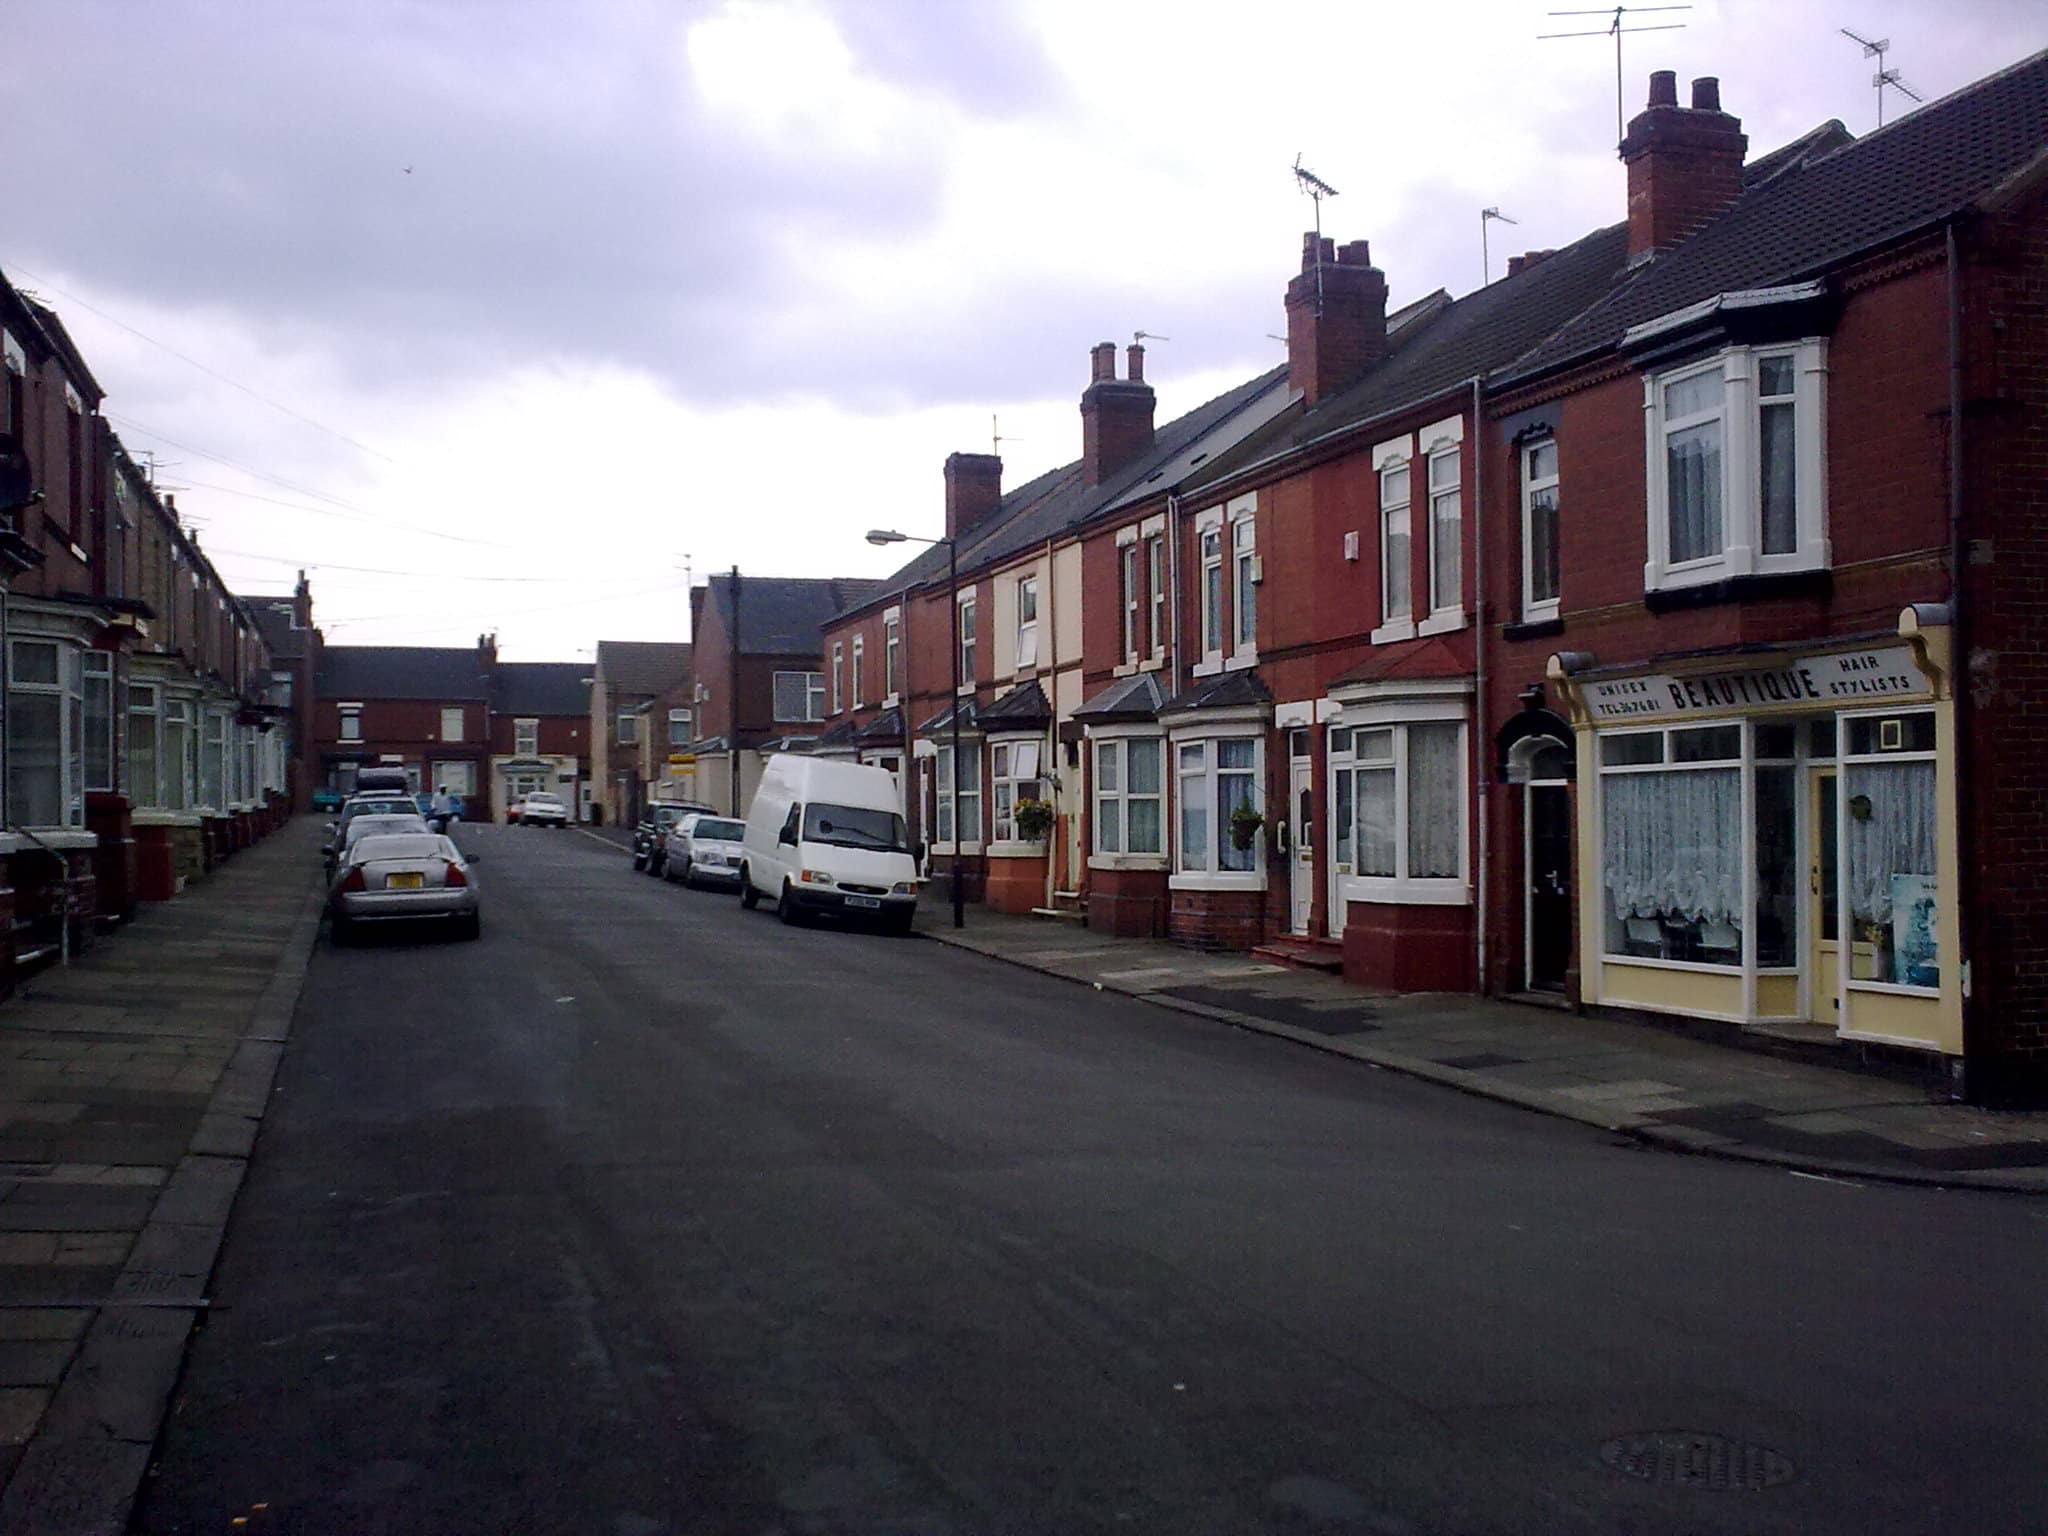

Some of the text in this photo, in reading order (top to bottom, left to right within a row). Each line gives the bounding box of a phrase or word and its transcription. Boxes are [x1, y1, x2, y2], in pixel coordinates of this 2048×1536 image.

[1839, 656, 1880, 672] HAIR
[1667, 669, 1820, 709] BEAUTIQUE
[1830, 676, 1910, 695] STYLISTS
